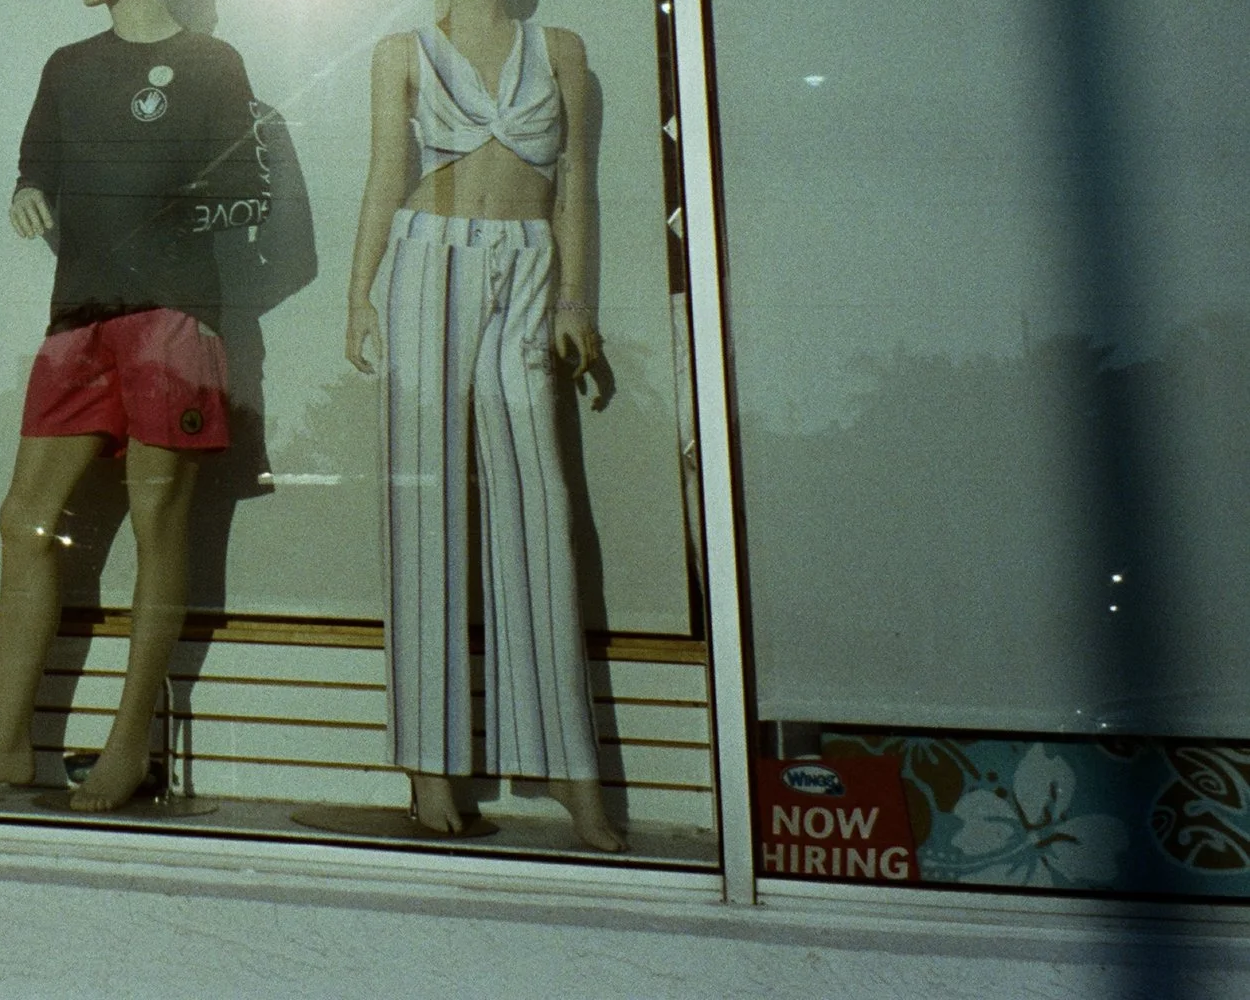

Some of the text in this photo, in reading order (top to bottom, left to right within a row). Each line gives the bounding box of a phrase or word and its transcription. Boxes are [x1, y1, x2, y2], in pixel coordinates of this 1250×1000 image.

[193, 199, 262, 233] LOVE
[771, 804, 881, 841] NOW
[761, 841, 910, 881] HIRING
